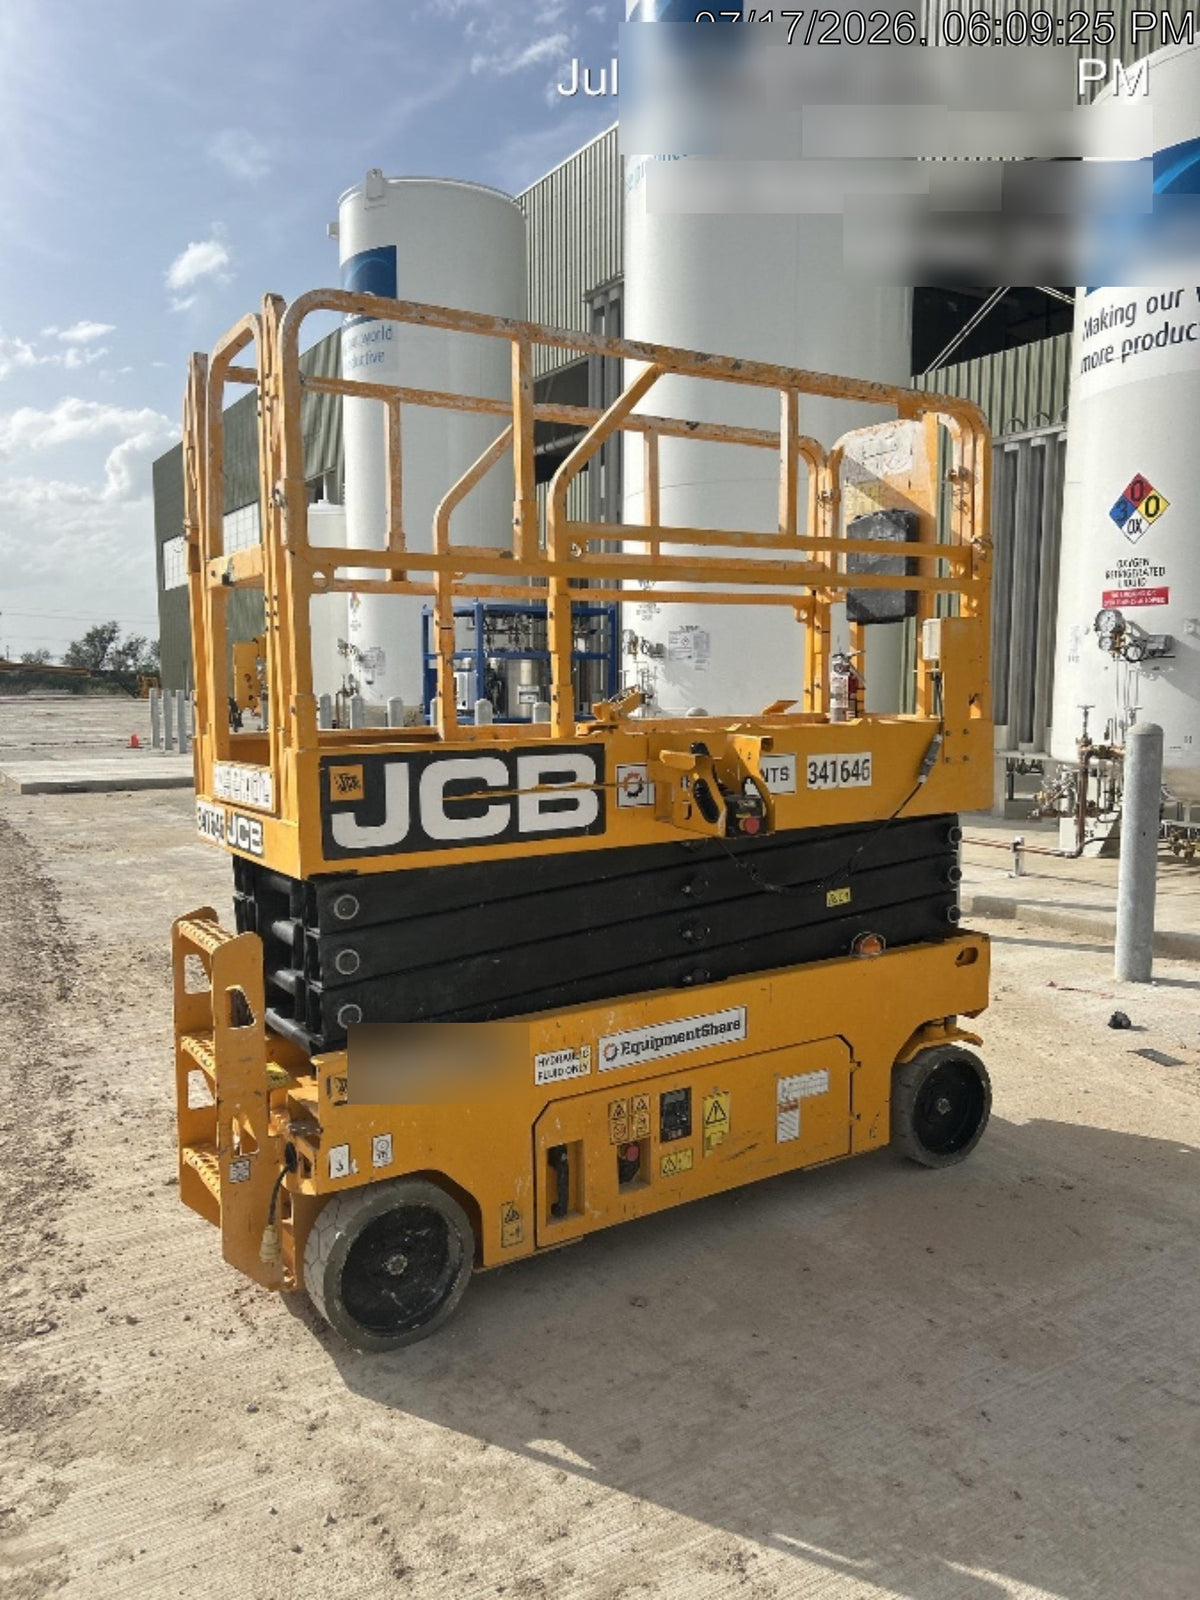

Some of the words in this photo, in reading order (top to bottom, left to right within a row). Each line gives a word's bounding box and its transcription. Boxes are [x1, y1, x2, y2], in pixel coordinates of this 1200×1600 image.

[1082, 301, 1137, 341] Making
[1146, 289, 1184, 315] our
[1080, 345, 1115, 375] more
[1121, 321, 1200, 364] produc
[1130, 479, 1145, 500] 0
[1144, 494, 1160, 518] 0
[1114, 500, 1129, 521] 3
[808, 758, 870, 785] 341646
[331, 753, 599, 849] JCB
[227, 812, 263, 855] JCB
[620, 1018, 741, 1057] EquipmentShare
[538, 1067, 564, 1081] FLUID
[565, 1060, 588, 1075] ONLY
